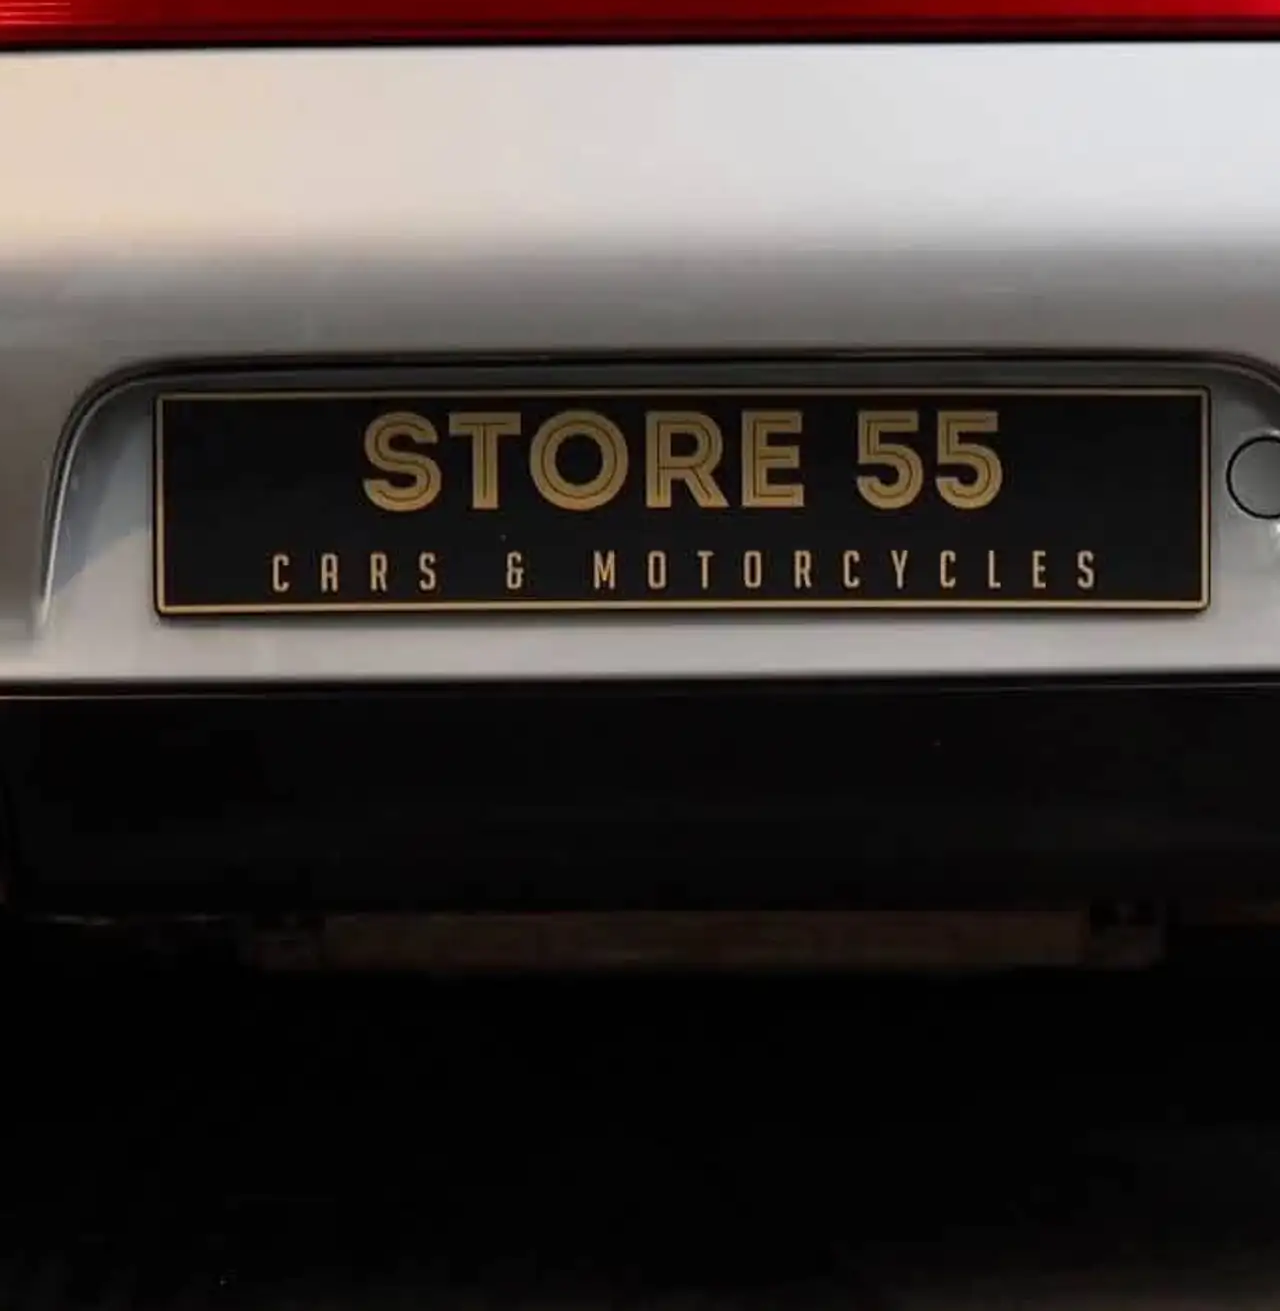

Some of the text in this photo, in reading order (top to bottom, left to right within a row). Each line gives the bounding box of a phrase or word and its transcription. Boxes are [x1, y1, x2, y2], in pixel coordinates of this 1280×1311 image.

[364, 410, 1003, 512] STORE 55
[272, 549, 1096, 592] CARS & MOTORCYCLES
